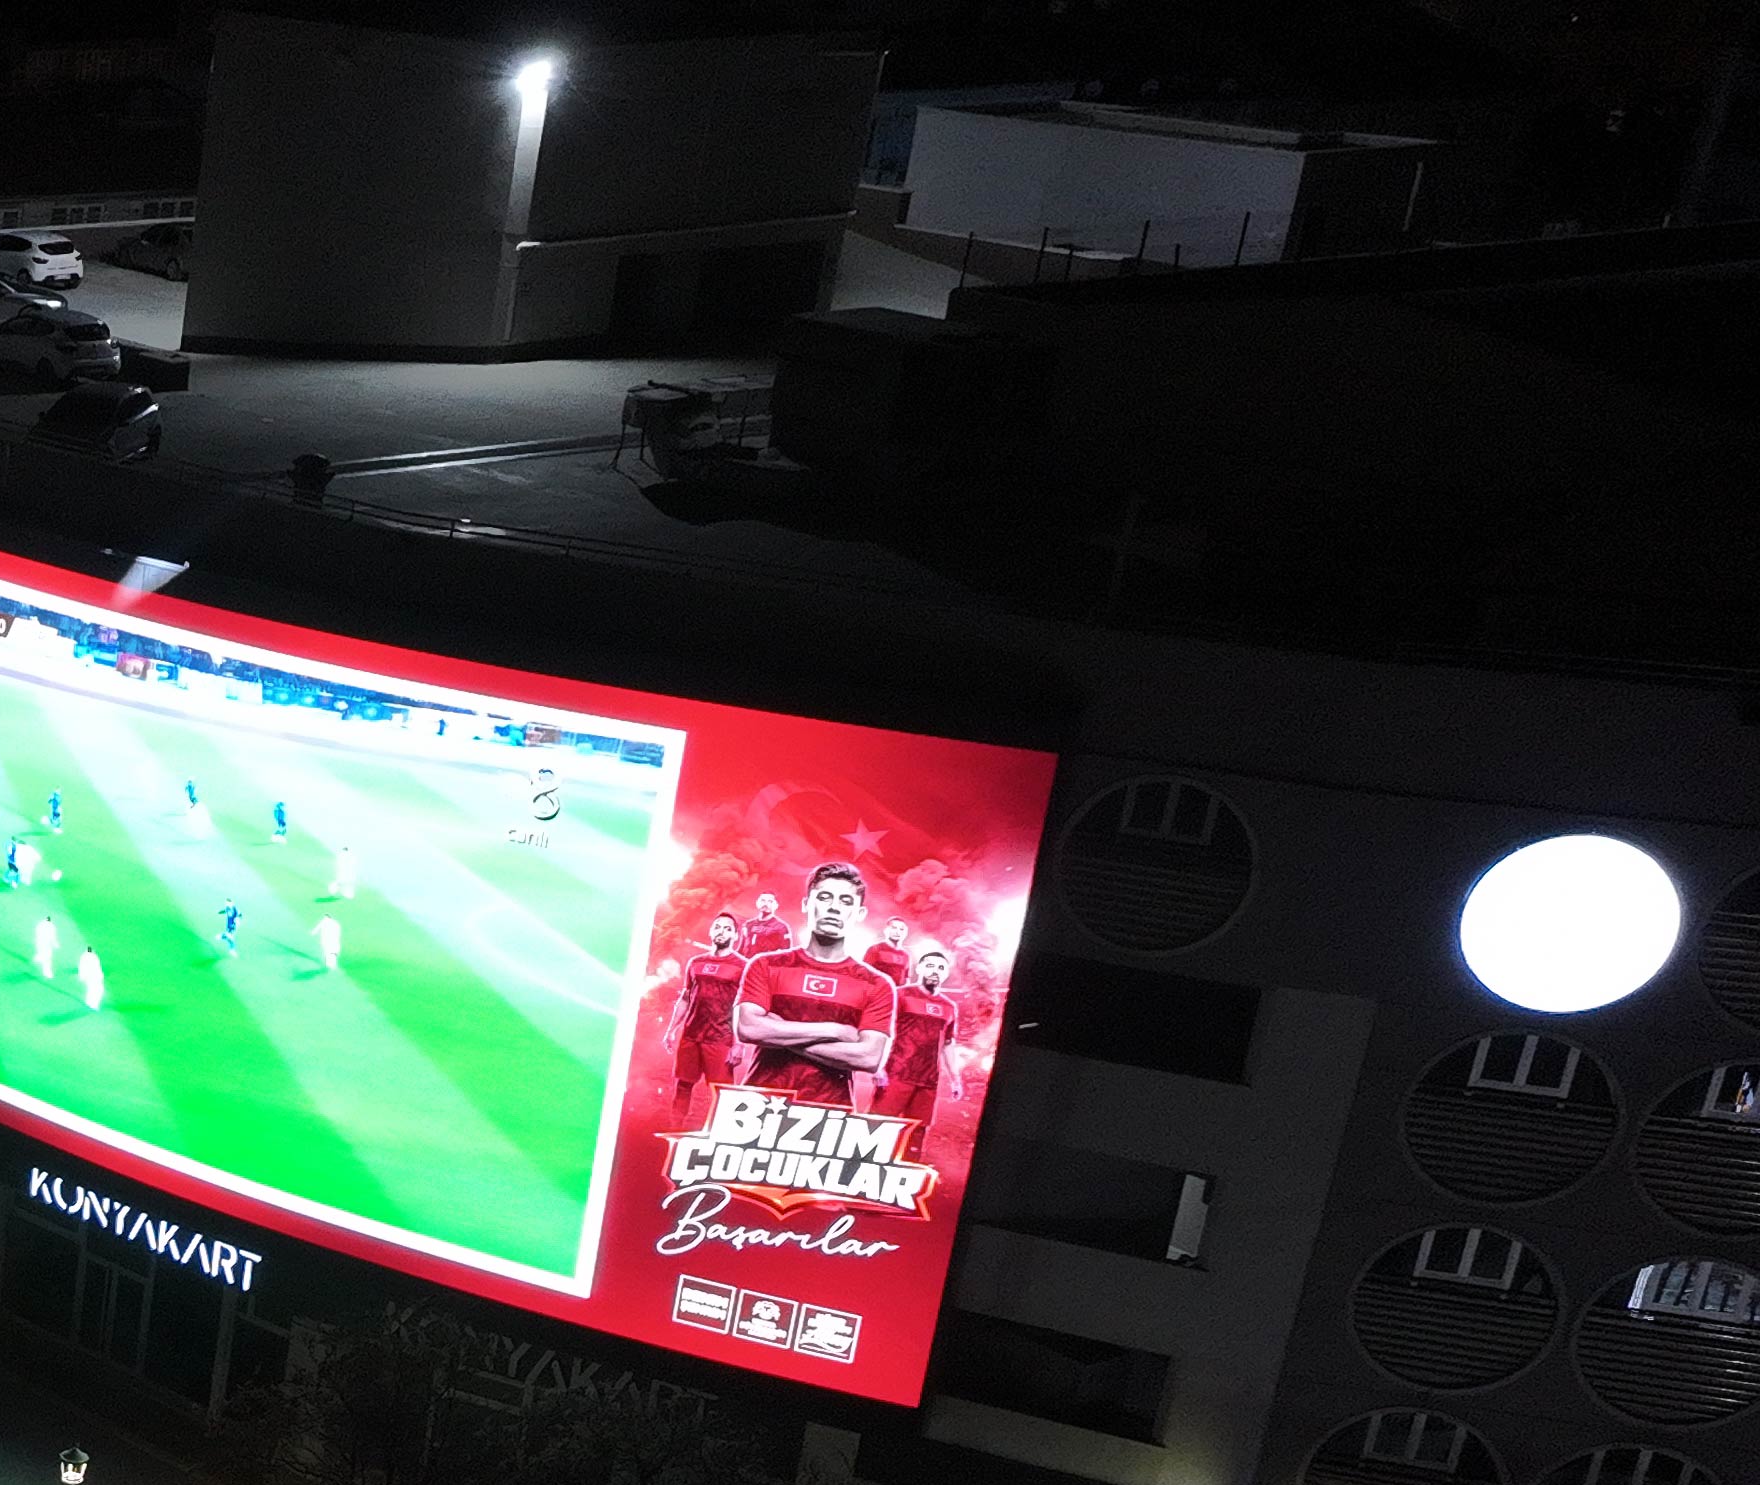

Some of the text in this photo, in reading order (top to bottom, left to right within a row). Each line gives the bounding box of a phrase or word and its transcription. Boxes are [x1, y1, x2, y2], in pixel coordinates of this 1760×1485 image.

[710, 1089, 907, 1164] BİZİM
[669, 1135, 926, 1210] ÇOCUKLAR
[28, 1167, 263, 1292] KONYAKART
[657, 1184, 900, 1258] Başarılar
